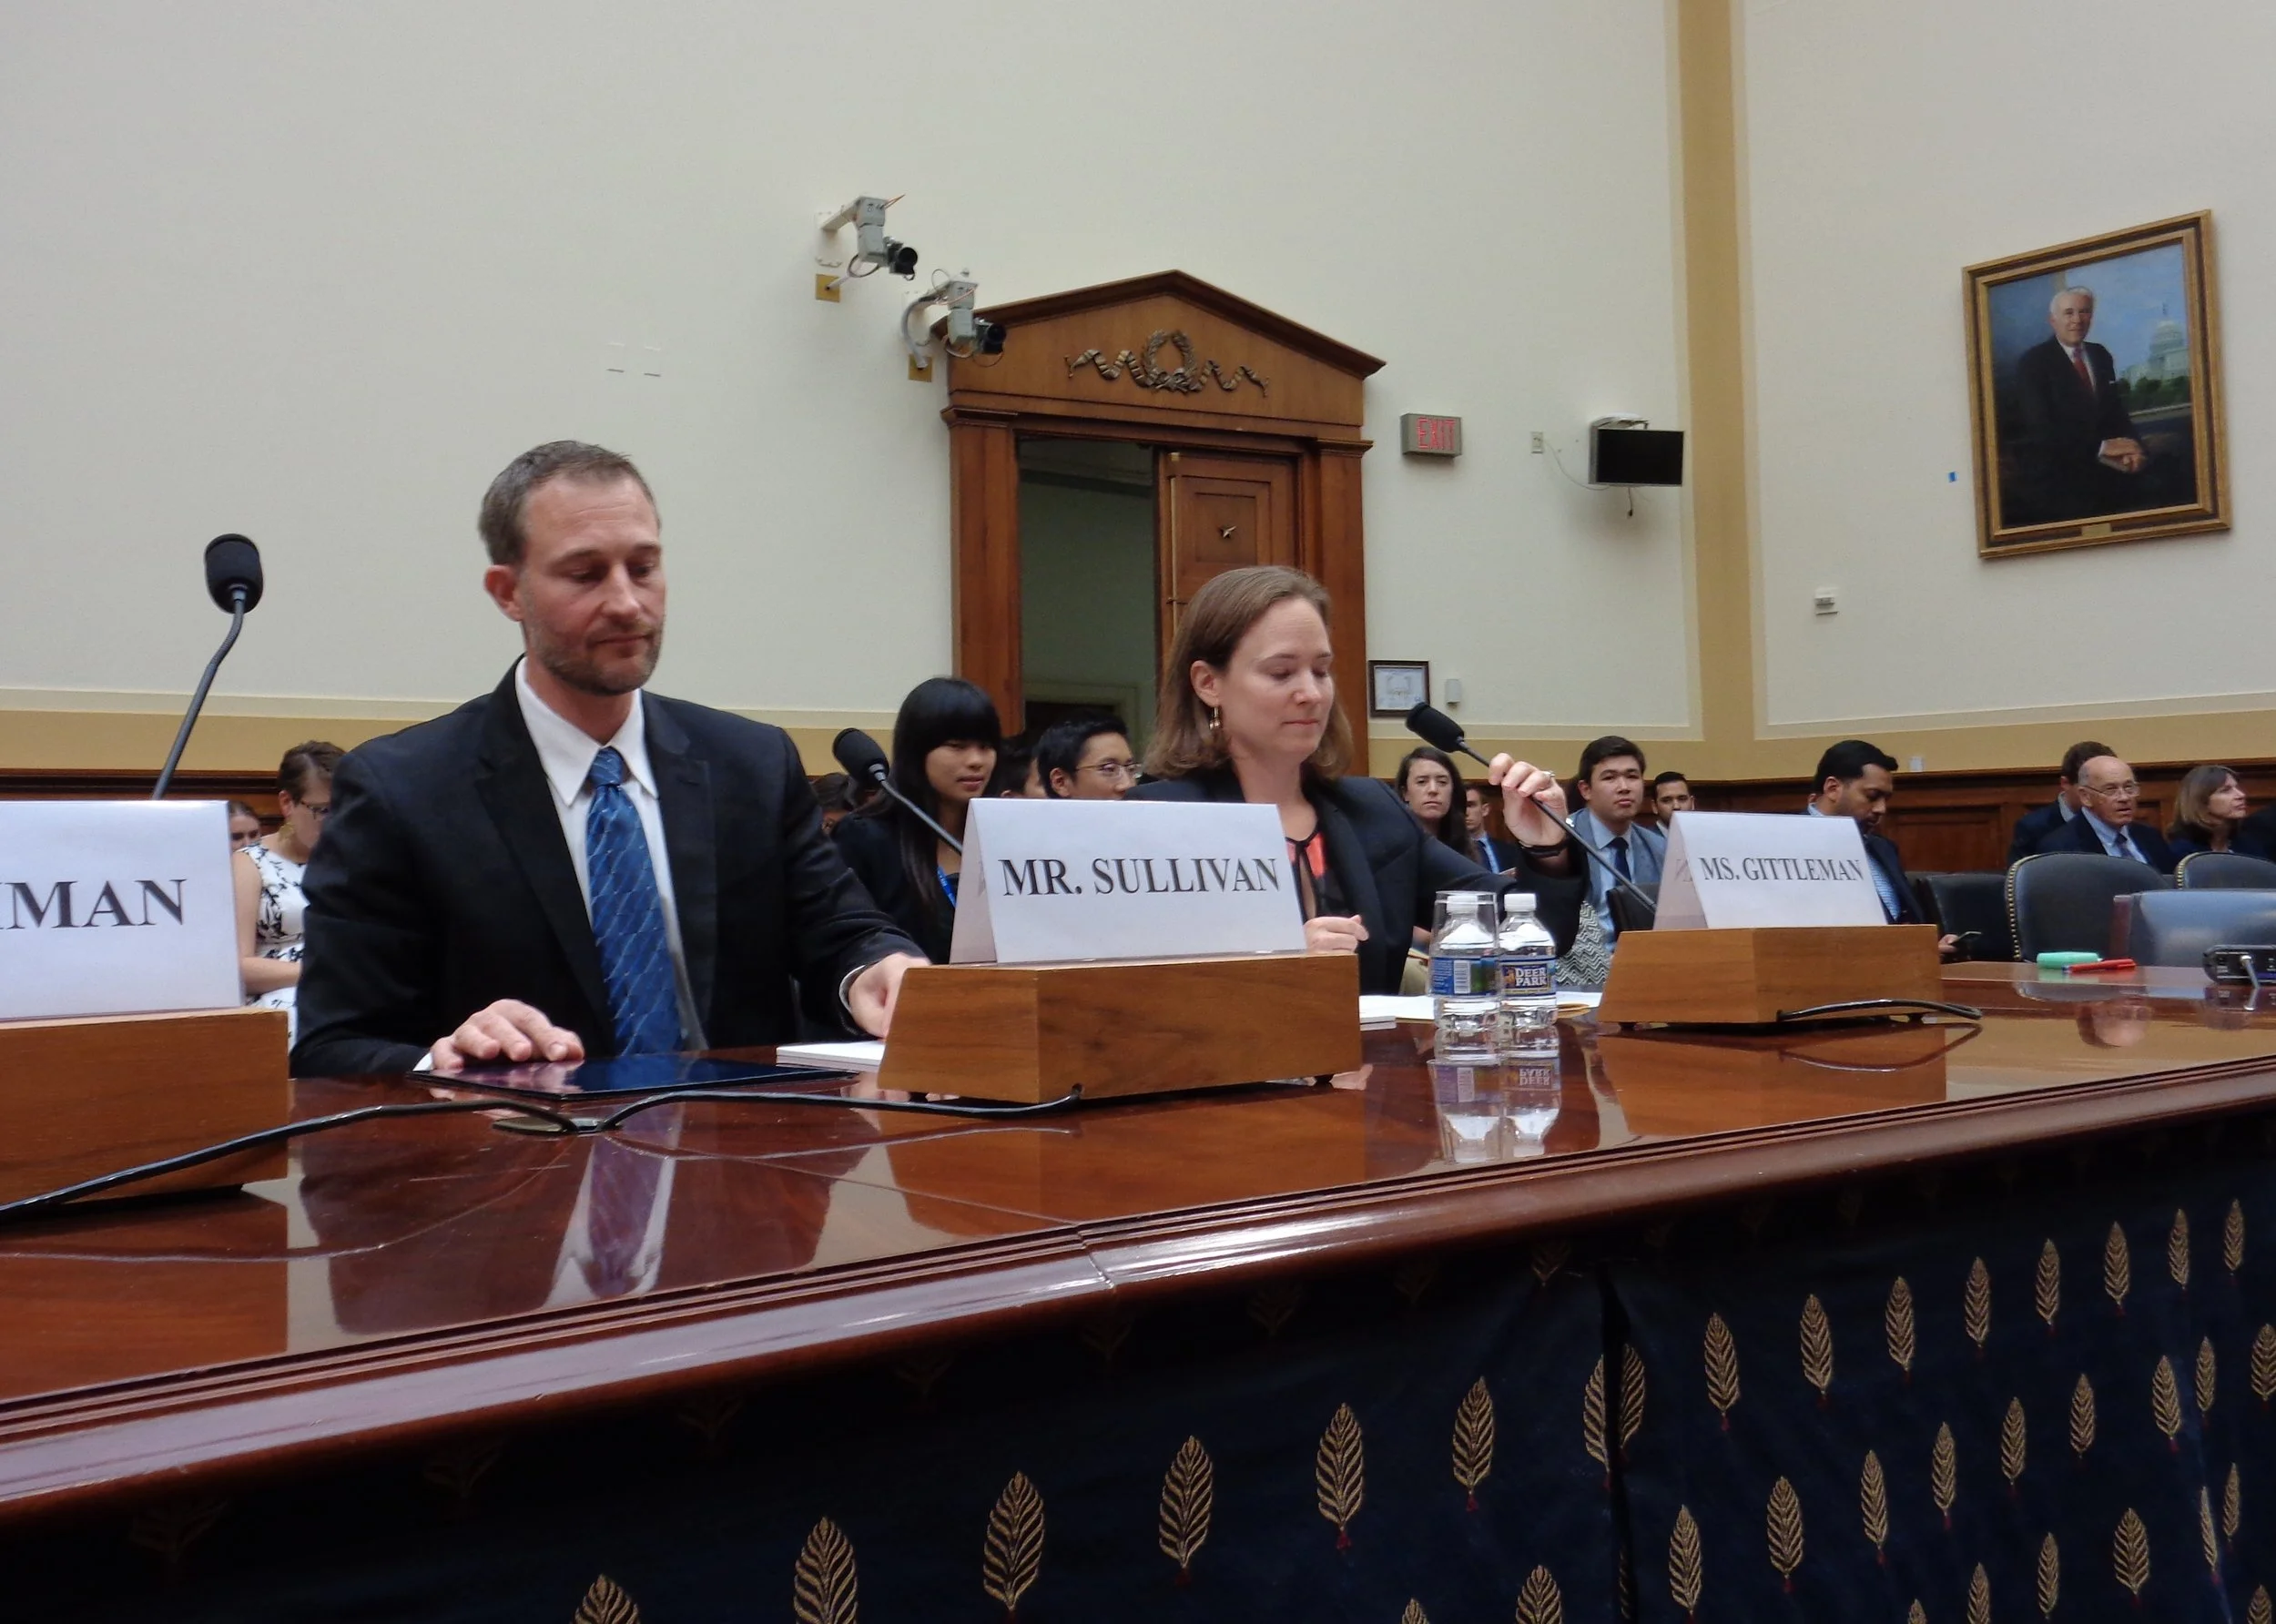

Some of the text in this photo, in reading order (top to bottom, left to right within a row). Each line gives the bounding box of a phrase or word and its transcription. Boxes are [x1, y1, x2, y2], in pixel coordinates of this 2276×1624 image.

[1416, 417, 1455, 451] EXIT
[998, 858, 1281, 897] MR. SULLIVAN
[1698, 857, 1740, 880] MS.
[1743, 858, 1864, 882] GITTLEMAN
[0, 878, 188, 930] MAN
[1515, 967, 1547, 978] DEER
[1516, 976, 1547, 987] PARK
